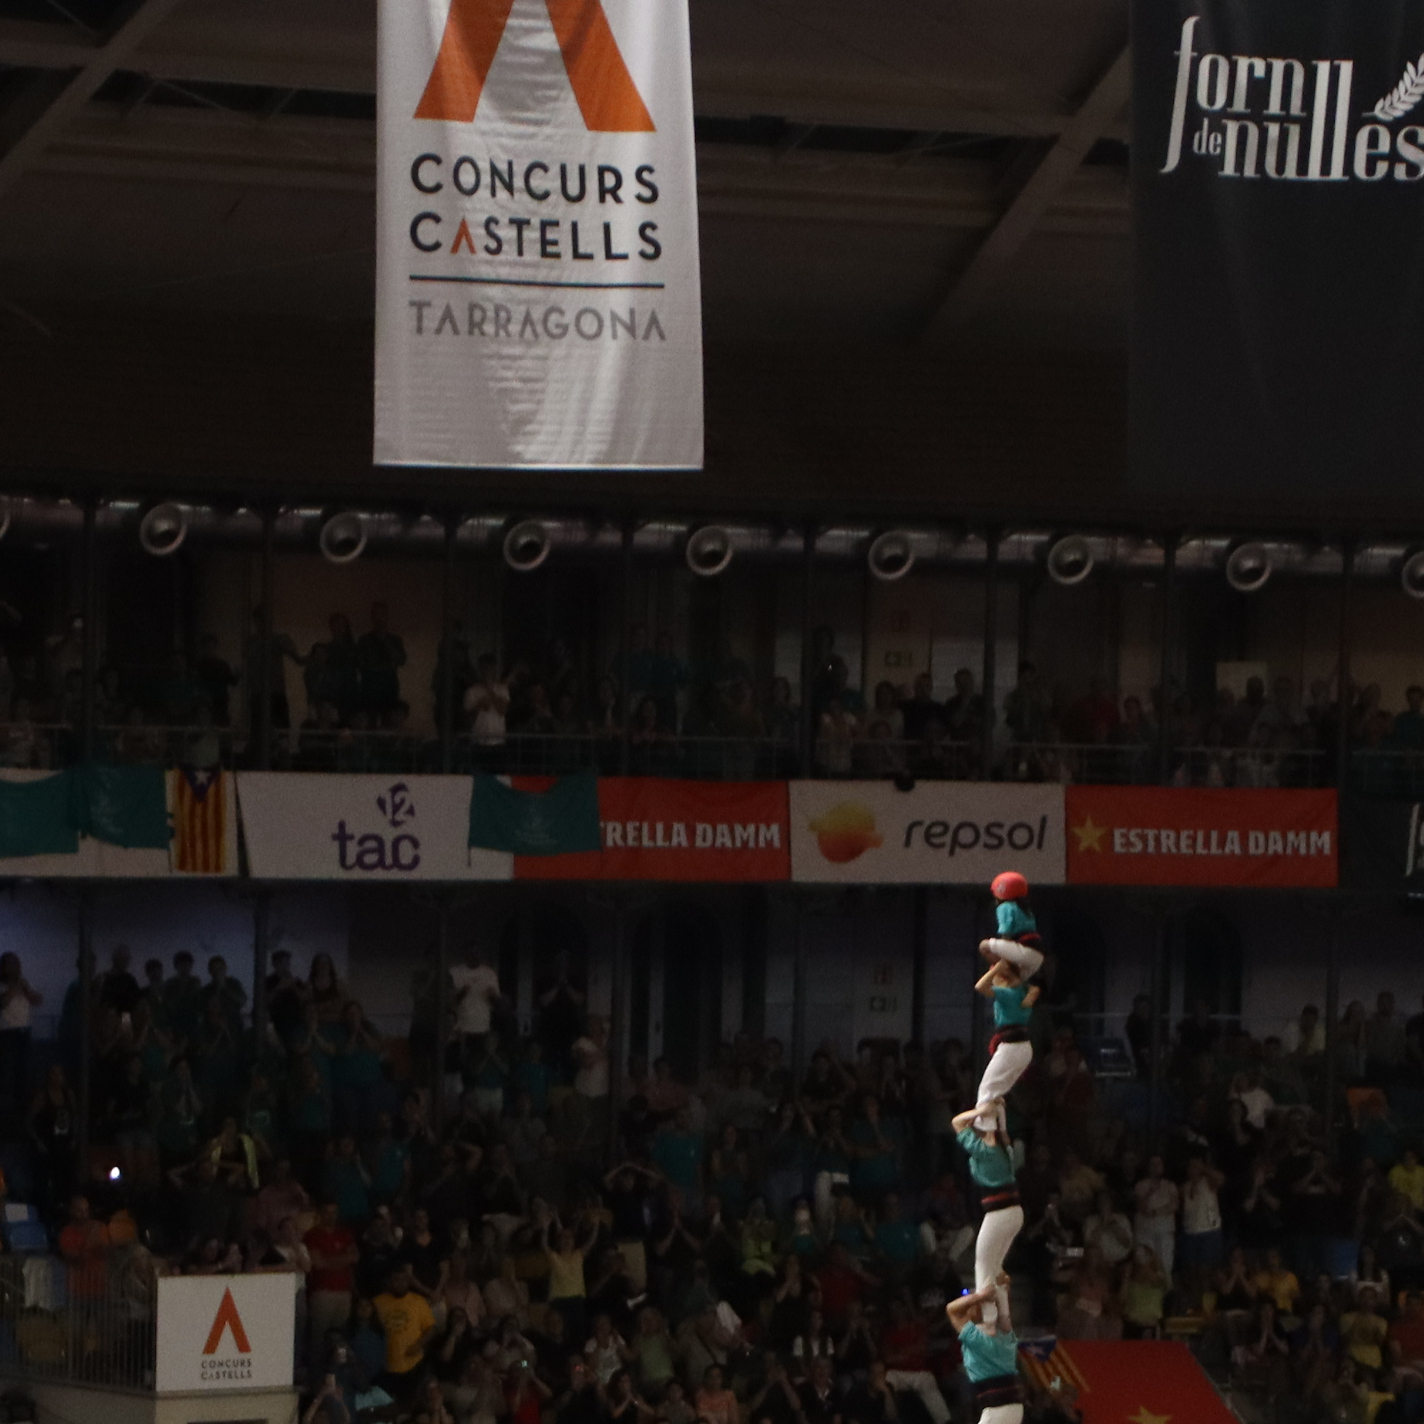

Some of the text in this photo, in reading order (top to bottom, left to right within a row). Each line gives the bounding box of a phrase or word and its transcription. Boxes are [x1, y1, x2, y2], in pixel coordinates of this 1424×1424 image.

[1159, 15, 1308, 175] forn
[1192, 117, 1223, 156] de
[410, 153, 659, 204] CONCURS
[409, 212, 662, 260] CASTELLS
[408, 300, 667, 341] TARRAGONA
[332, 820, 421, 872] tac
[694, 823, 781, 850] DAMM
[903, 815, 1049, 857] repsol
[1113, 828, 1332, 857] ESTRELLA DAMM
[200, 1370, 253, 1380] CASTELLS
[201, 1359, 252, 1368] CONCURS
